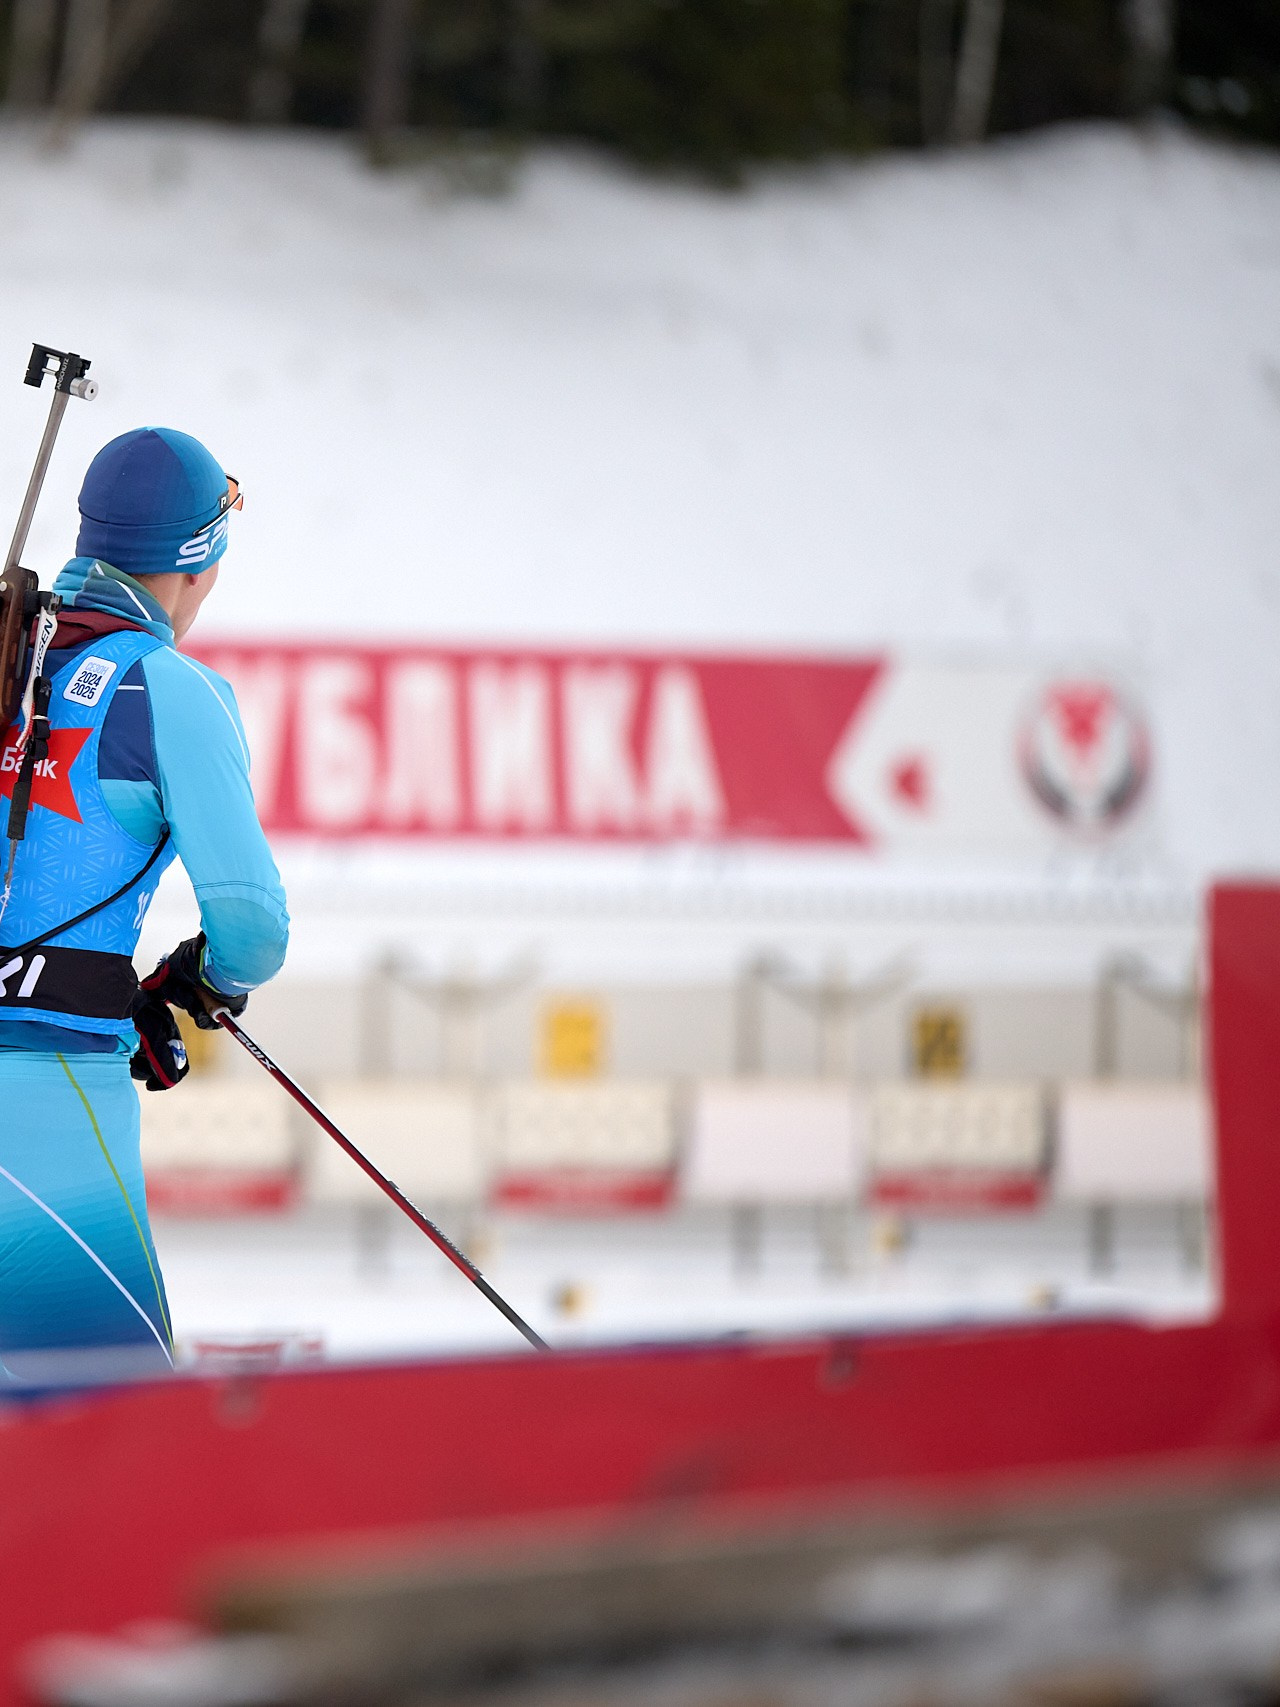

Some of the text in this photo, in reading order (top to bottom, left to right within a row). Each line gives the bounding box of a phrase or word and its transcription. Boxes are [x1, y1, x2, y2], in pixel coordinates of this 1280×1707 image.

[85, 661, 109, 676] СЕЗОН
[77, 670, 103, 687] 2024
[70, 682, 97, 700] 2025
